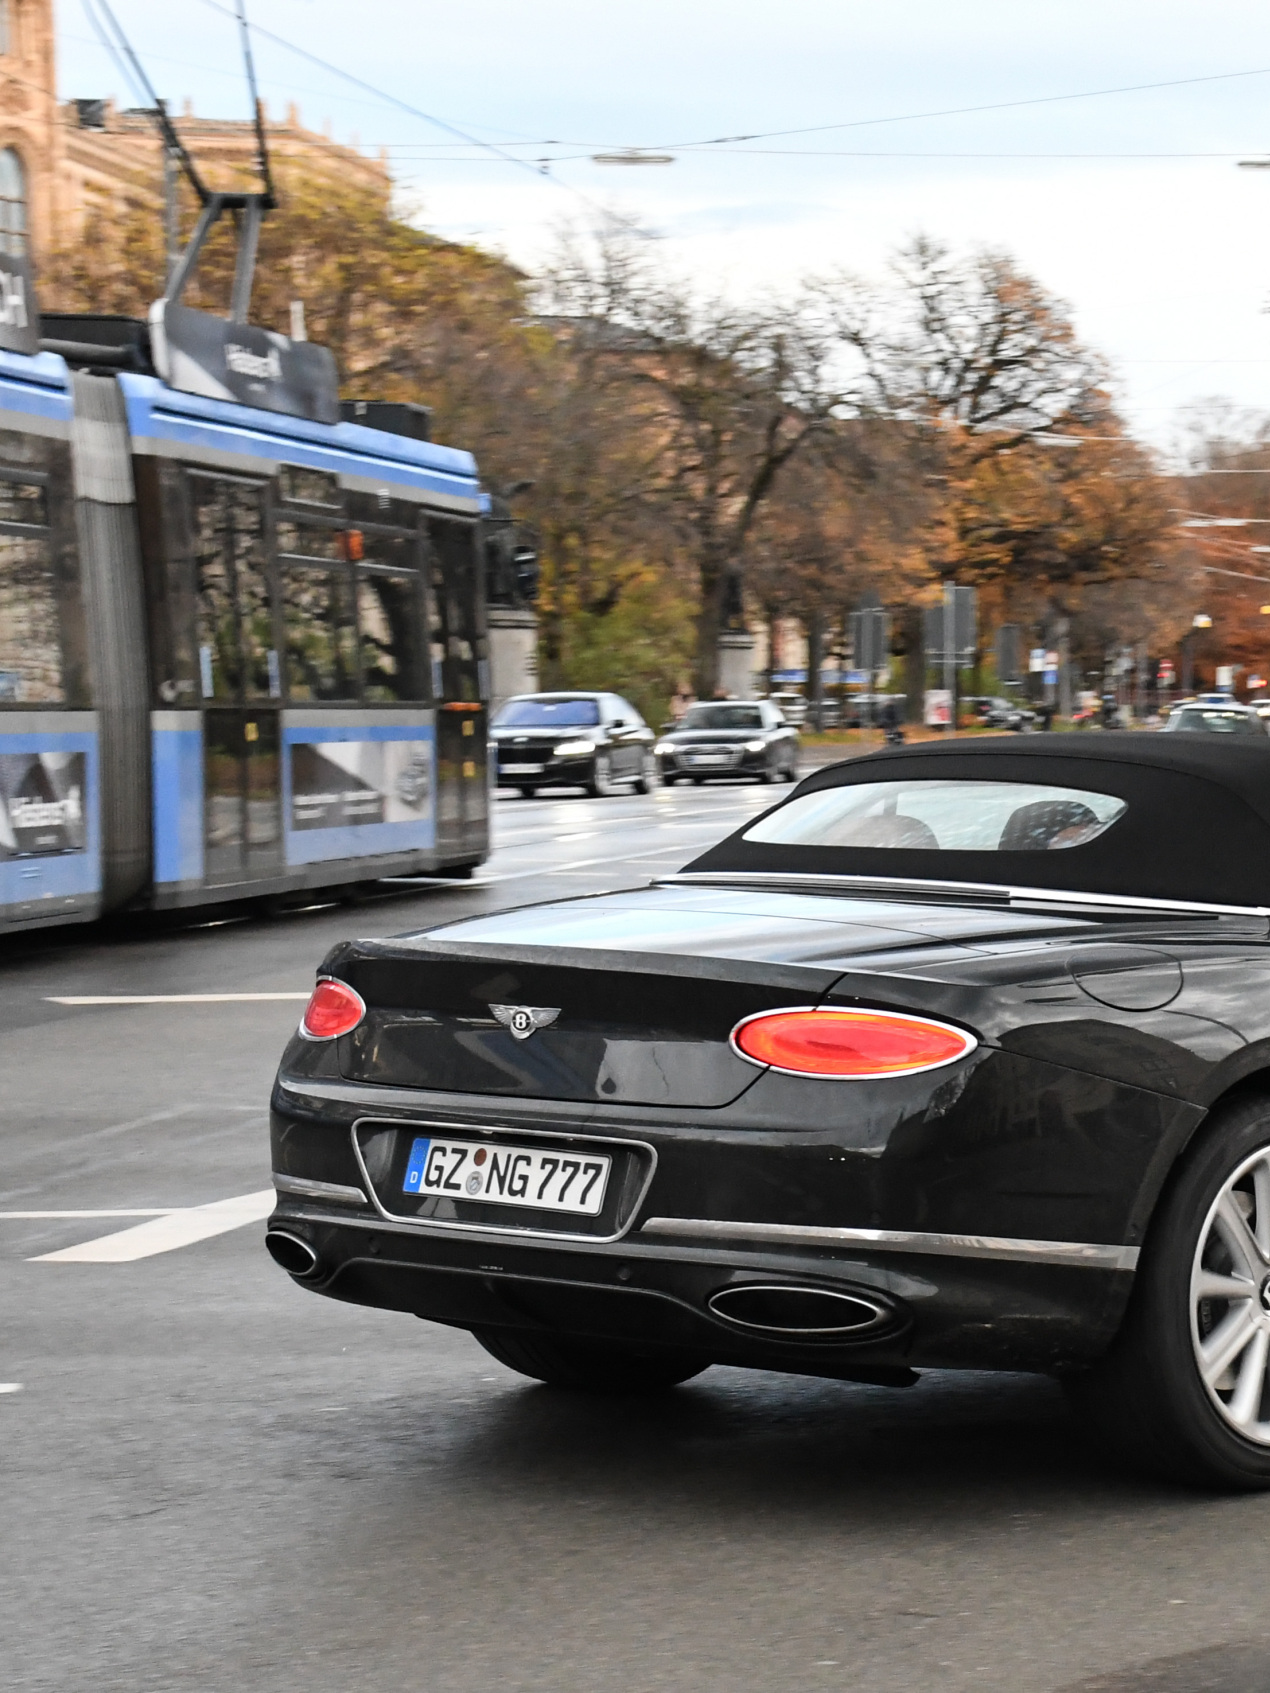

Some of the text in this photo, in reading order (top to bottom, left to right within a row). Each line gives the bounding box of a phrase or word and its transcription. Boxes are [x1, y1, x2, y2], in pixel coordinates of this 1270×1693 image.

[409, 1171, 419, 1184] D
[424, 1146, 604, 1206] GZ NG 777
